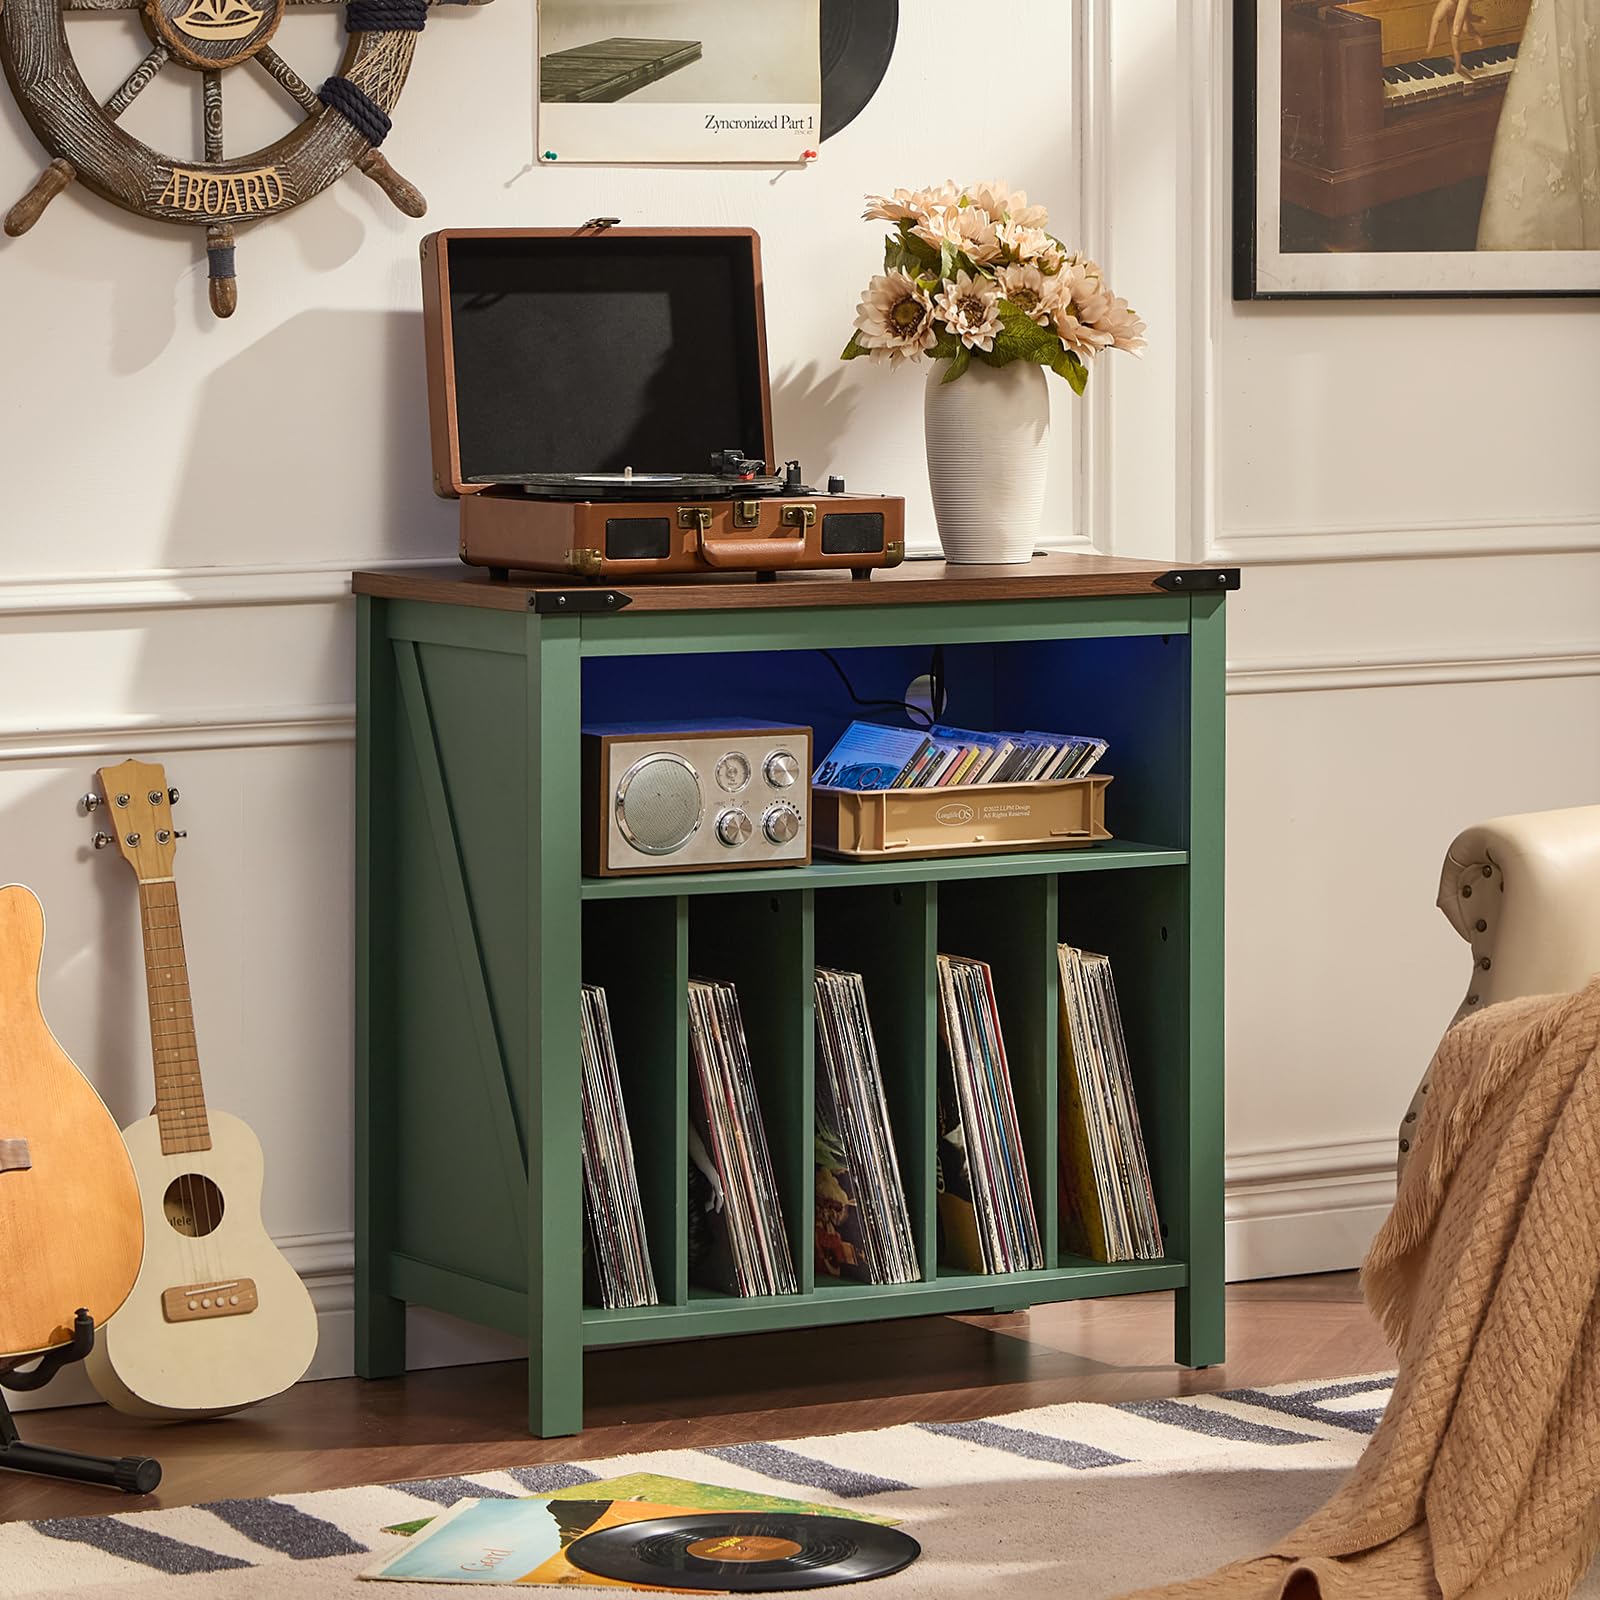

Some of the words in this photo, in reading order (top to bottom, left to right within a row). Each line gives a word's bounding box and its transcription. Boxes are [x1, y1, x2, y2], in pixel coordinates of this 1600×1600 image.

[704, 114, 778, 134] Zyncronized
[780, 114, 805, 130] Part
[807, 115, 814, 129] 1
[156, 166, 284, 215] ABOARD
